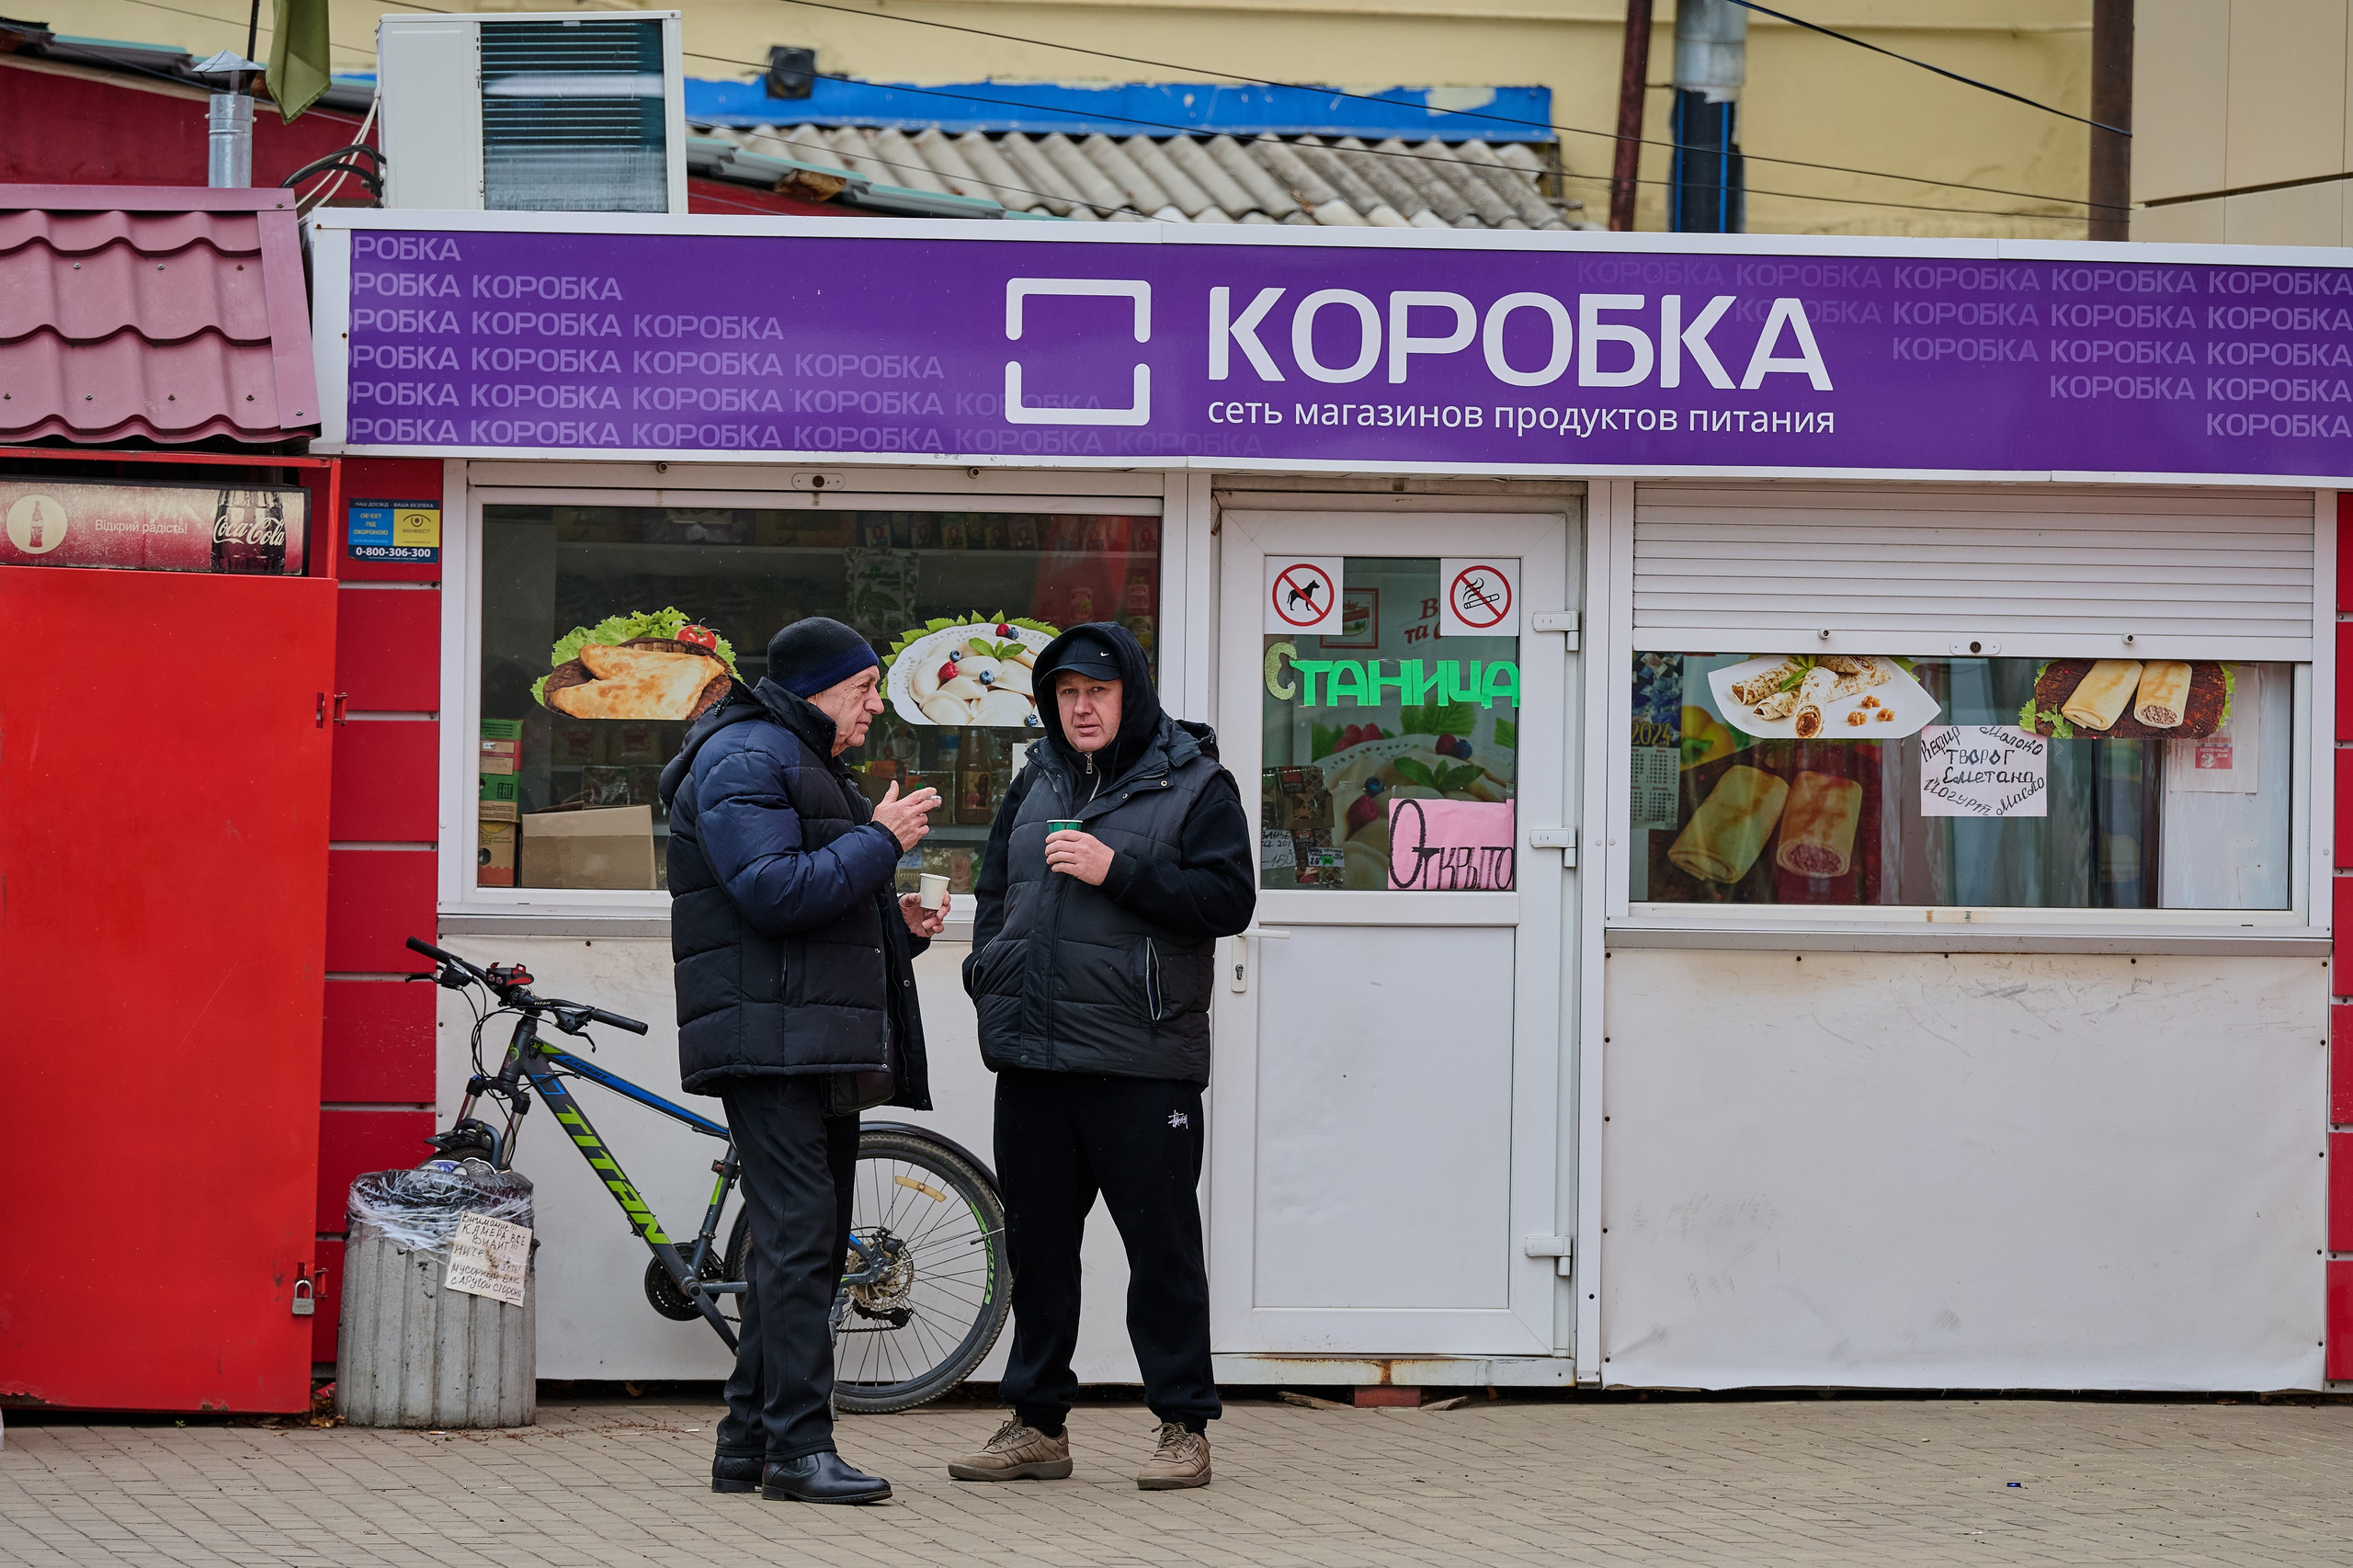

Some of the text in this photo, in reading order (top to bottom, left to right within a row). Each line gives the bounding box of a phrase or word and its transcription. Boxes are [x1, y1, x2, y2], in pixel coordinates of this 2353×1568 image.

[350, 236, 463, 261] РОБКА
[350, 273, 622, 301] РОБКА КОРОБКА
[1894, 266, 2040, 290] КОРОБКА
[2052, 268, 2197, 293] КОРОБКА
[349, 309, 783, 340] РОБКА КОРОБКА КОРОБКА
[1893, 301, 2039, 326] КОРОБКА
[2051, 304, 2196, 329] КОРОБКА
[1208, 286, 1835, 392] КОРОБКА
[1893, 336, 2039, 362] КОРОБКА
[2050, 339, 2195, 365] КОРОБКА
[348, 346, 944, 379] РОБКА КОРОБКА КОРОБКА КОРОБКА
[347, 381, 460, 406] РОБКА
[472, 384, 621, 409] КОРОБКА
[633, 388, 783, 412] КОРОБКА
[795, 390, 944, 415] КОРОБКА
[2050, 375, 2195, 401] КОРОБКА
[347, 417, 460, 443] РОБКА
[472, 420, 620, 446] КОРОБКА
[633, 424, 782, 449] КОРОБКА
[793, 426, 943, 451] КОРОБКА
[1208, 401, 1836, 438] сеть магазинов продуктов питания
[95, 518, 188, 535] Відкрий радість!
[213, 515, 286, 546] Coca-Cola
[356, 547, 431, 557] 0-800-306-300
[1631, 722, 1671, 746] 2024
[1921, 726, 1961, 763] Кефир
[1979, 726, 2044, 756] Молоко
[499, 785, 512, 799] EAC
[556, 1103, 672, 1244] TITAN
